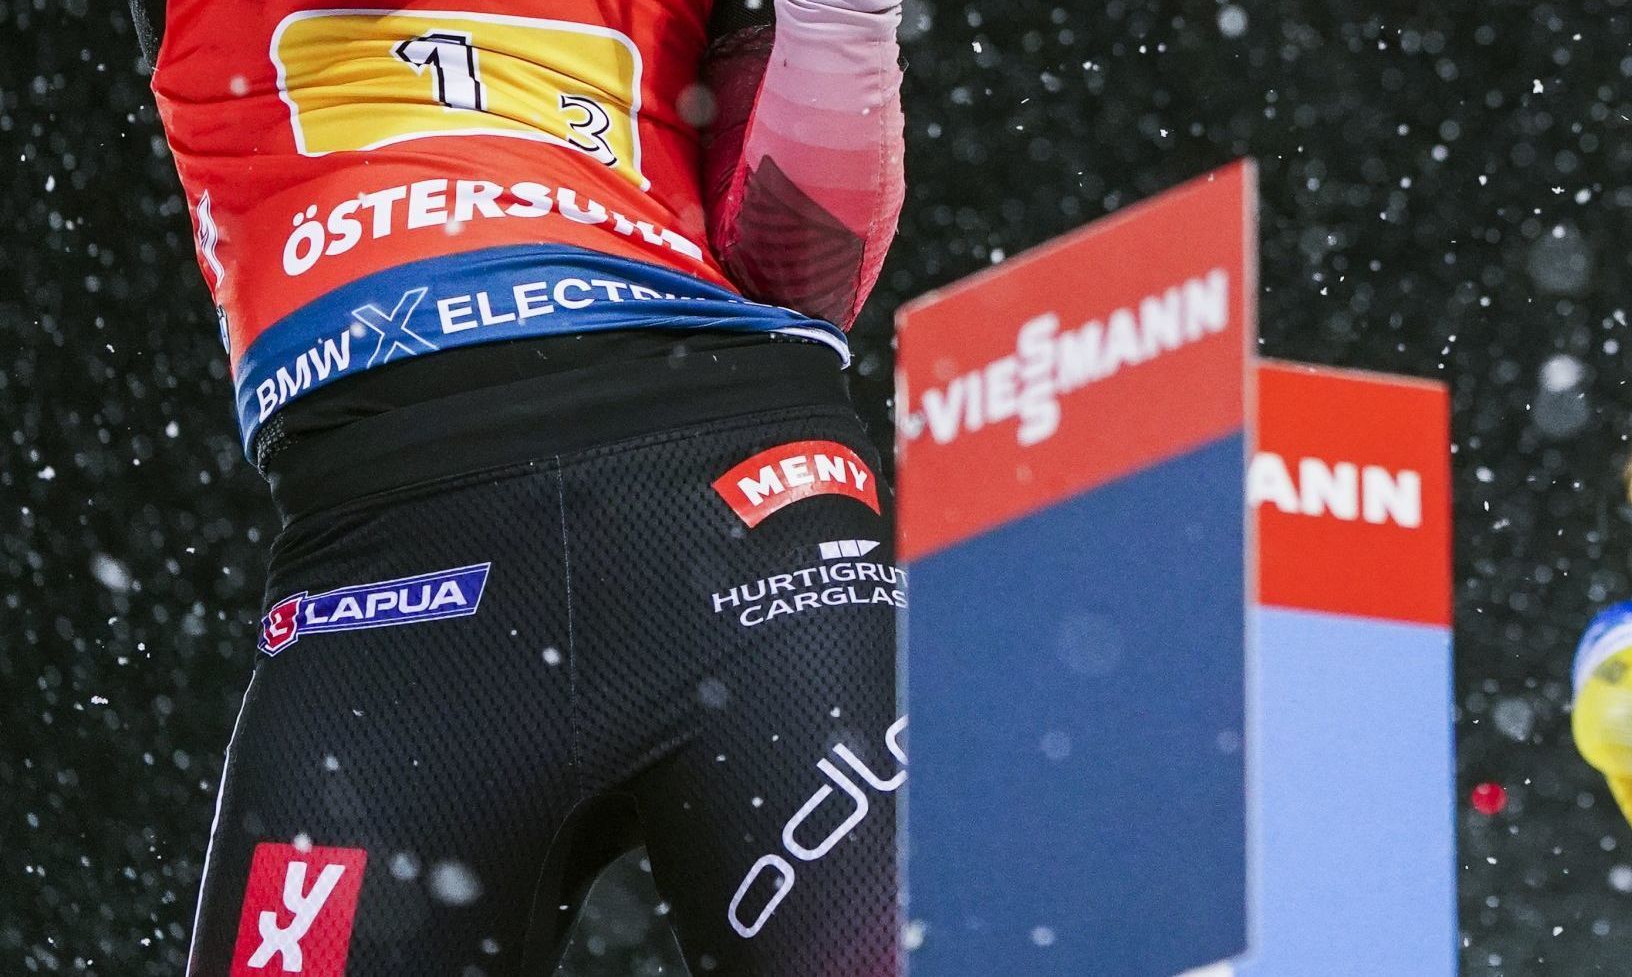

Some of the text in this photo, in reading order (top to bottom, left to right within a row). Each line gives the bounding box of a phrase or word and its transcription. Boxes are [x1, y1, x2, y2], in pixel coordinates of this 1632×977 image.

[398, 31, 485, 112] 1
[560, 95, 616, 167] 3
[256, 329, 350, 424] BMW
[921, 268, 1230, 447] VIESSMANN
[736, 454, 868, 507] MENY
[304, 580, 467, 625] LAPUA
